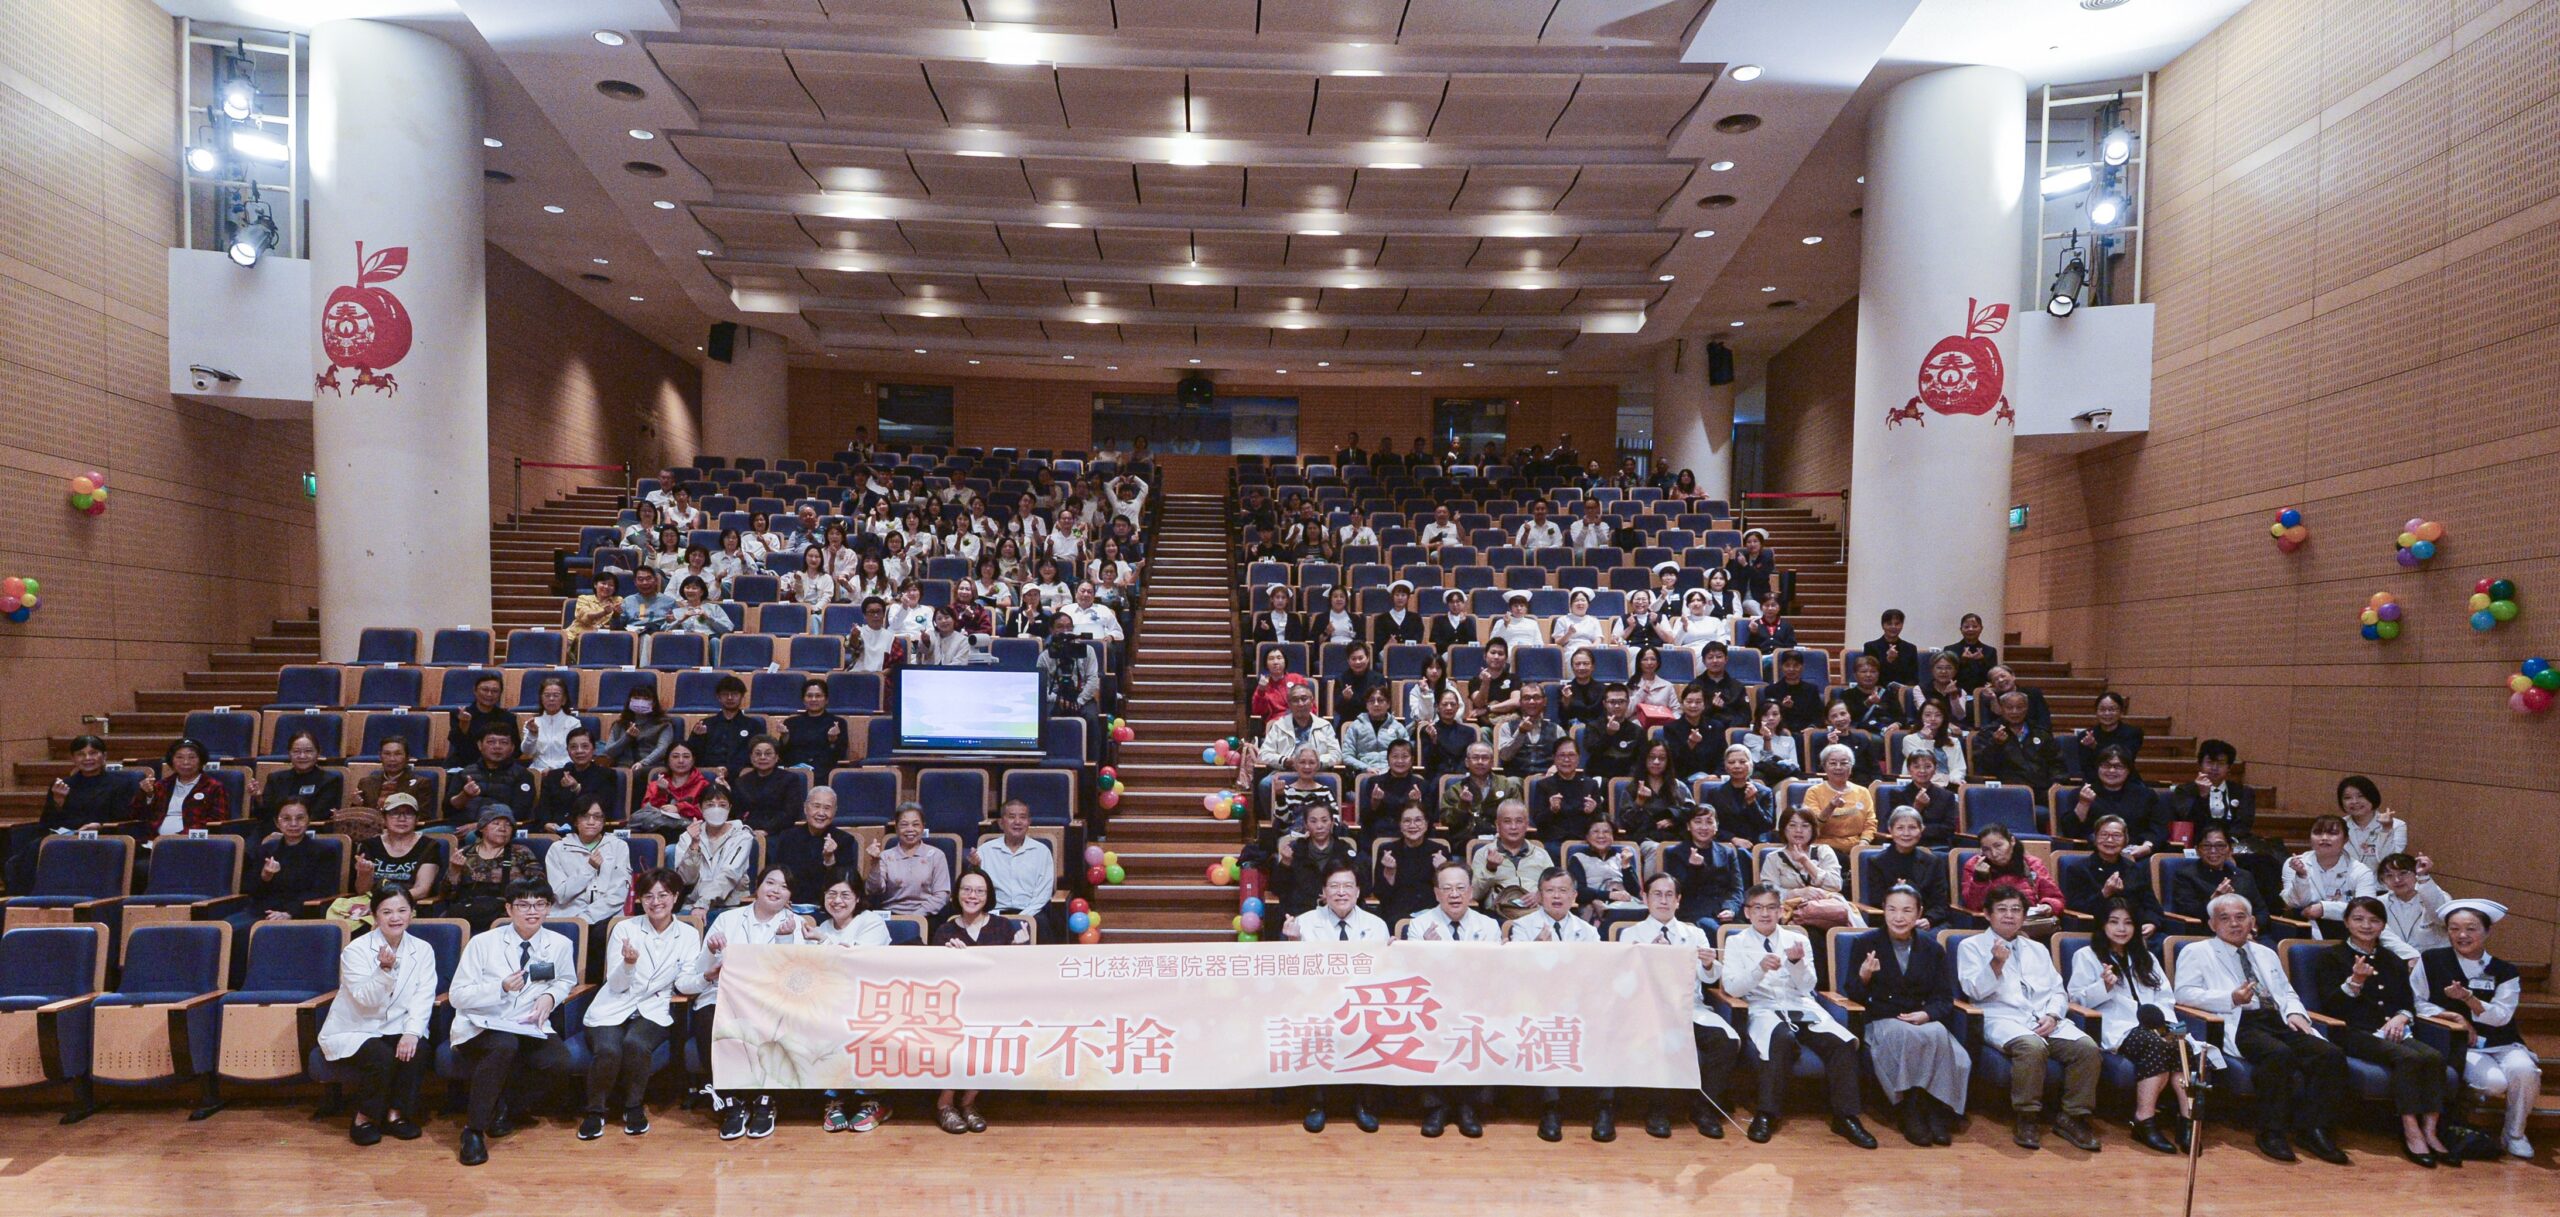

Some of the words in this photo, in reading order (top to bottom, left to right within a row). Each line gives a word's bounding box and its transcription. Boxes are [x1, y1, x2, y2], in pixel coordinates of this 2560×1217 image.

[1058, 952, 1375, 978] 台北慈濟醫院器官捐贈感恩會
[844, 979, 1177, 1078] 器而不捨
[1266, 975, 1585, 1074] 讓愛永續
